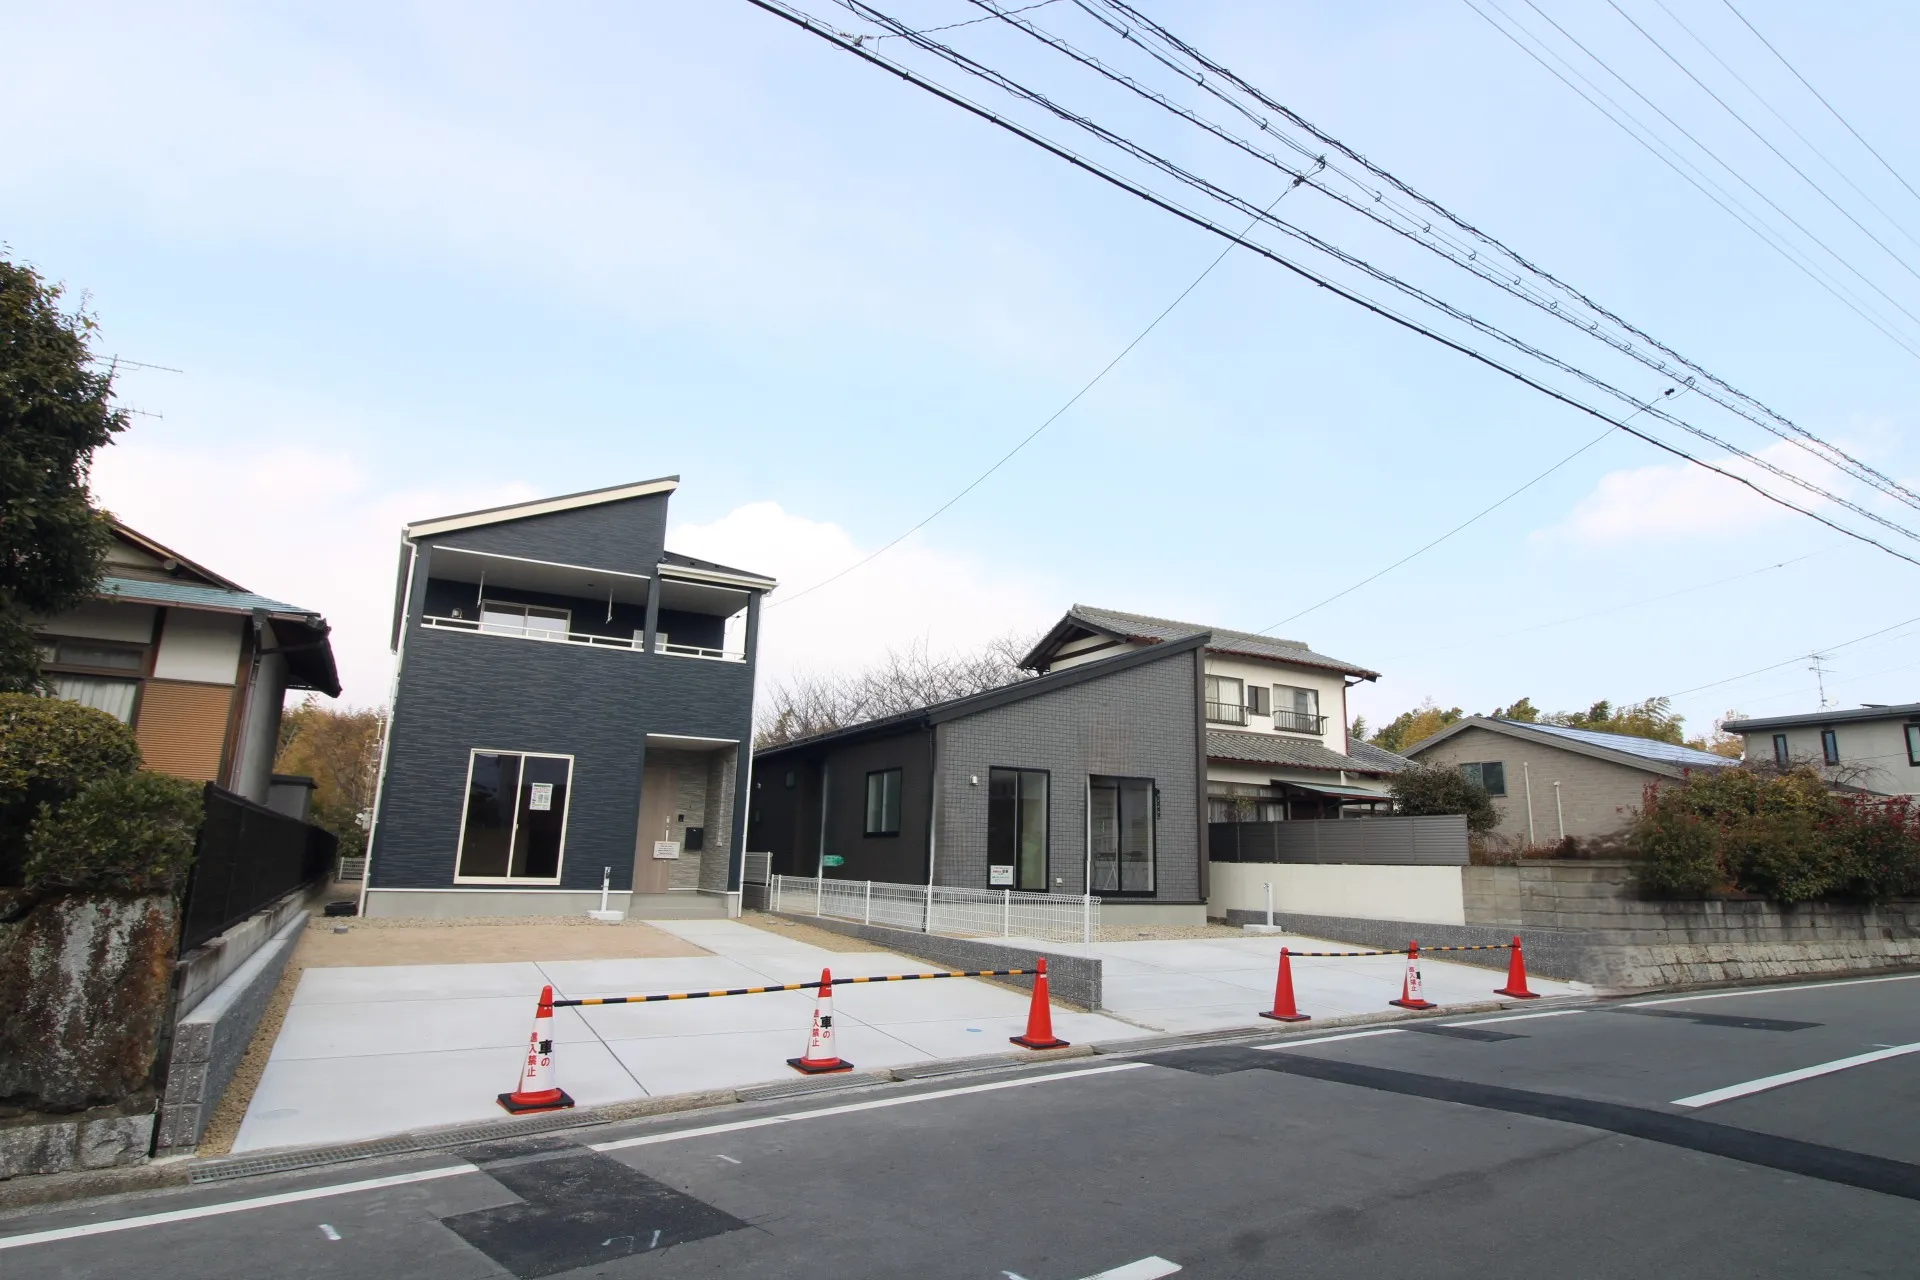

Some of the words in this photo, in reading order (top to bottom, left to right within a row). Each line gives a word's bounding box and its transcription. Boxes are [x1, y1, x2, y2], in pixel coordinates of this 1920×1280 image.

[820, 1015, 832, 1039] 車の
[527, 1032, 538, 1078] 進入禁止
[538, 1039, 553, 1067] 車の
